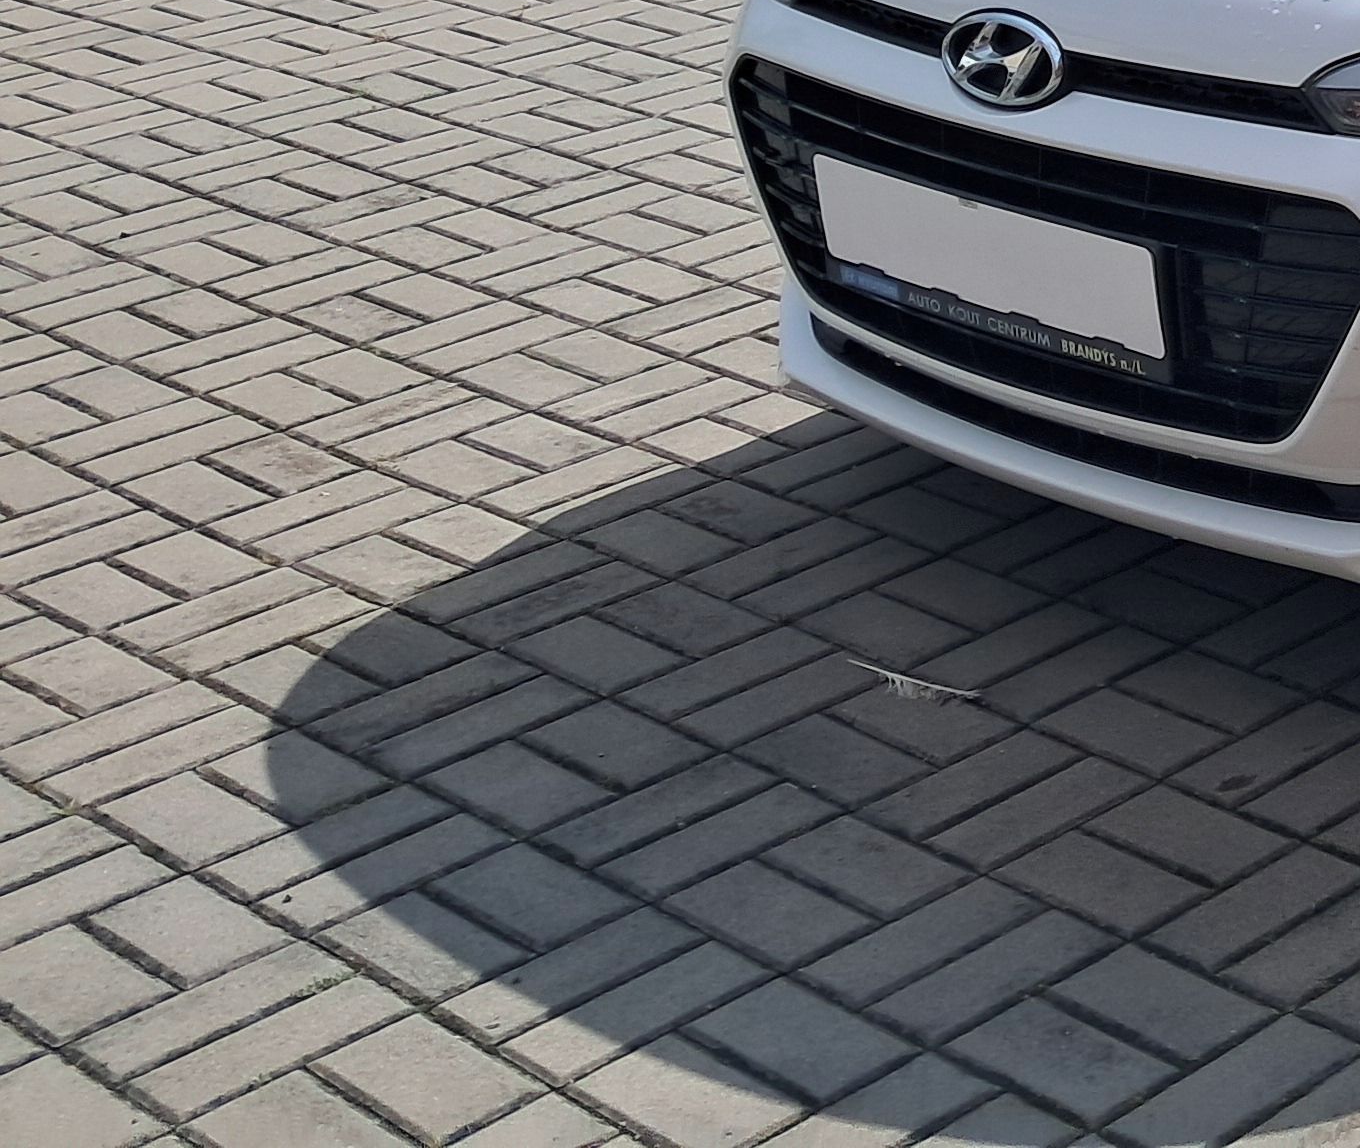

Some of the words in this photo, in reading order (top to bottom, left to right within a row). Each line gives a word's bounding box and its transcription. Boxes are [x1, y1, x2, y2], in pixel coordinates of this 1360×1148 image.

[908, 292, 941, 313] AUTO
[948, 304, 981, 326] KOUT
[987, 317, 1051, 348] CENTRUM
